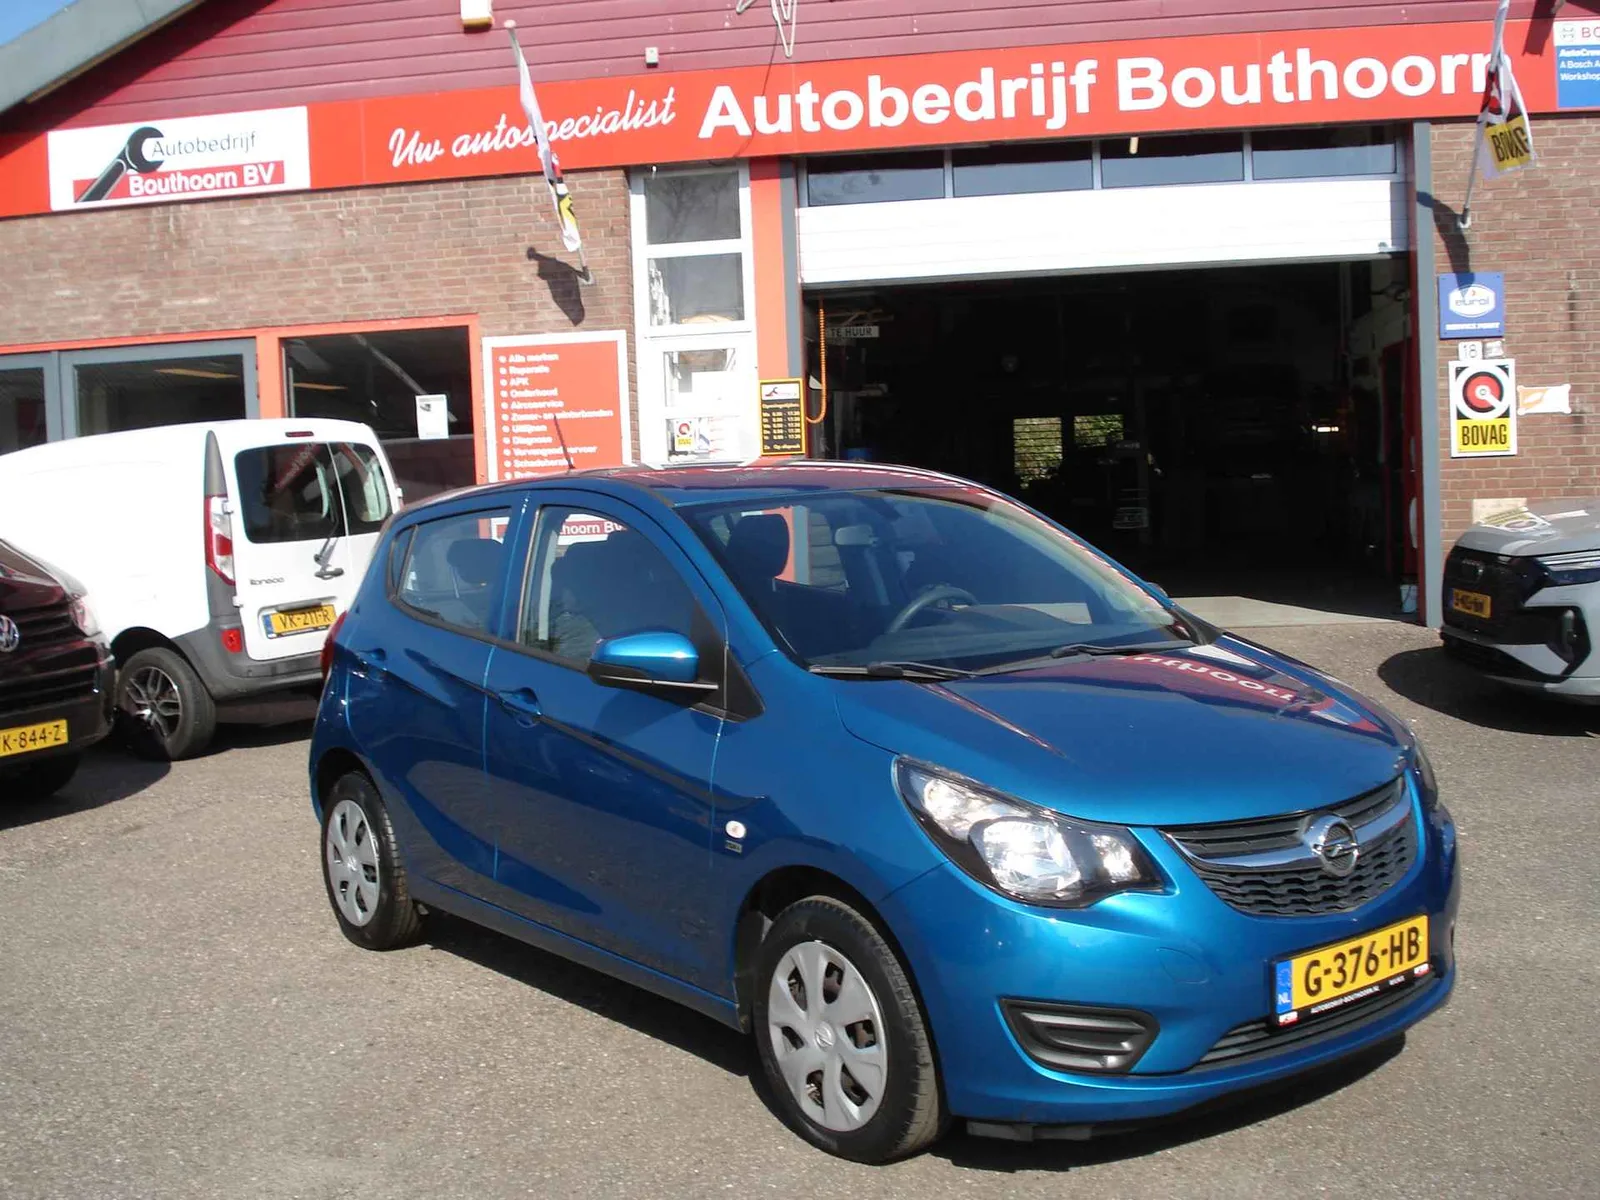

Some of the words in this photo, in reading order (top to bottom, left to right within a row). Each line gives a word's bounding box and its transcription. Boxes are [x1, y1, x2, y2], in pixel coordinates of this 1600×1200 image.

[698, 59, 1098, 139] Autobedrijf
[151, 130, 257, 158] Autobedrijf
[389, 128, 445, 167] Uw
[128, 167, 237, 196] Bouthoorn
[244, 163, 275, 186] BV
[830, 327, 843, 338] TE
[844, 326, 873, 337] HUUR
[509, 377, 529, 386] APK
[1461, 424, 1508, 446] BOVAG
[560, 523, 600, 535] hoorn
[1304, 926, 1420, 997] G-376-HB
[1277, 993, 1291, 1005] NL
